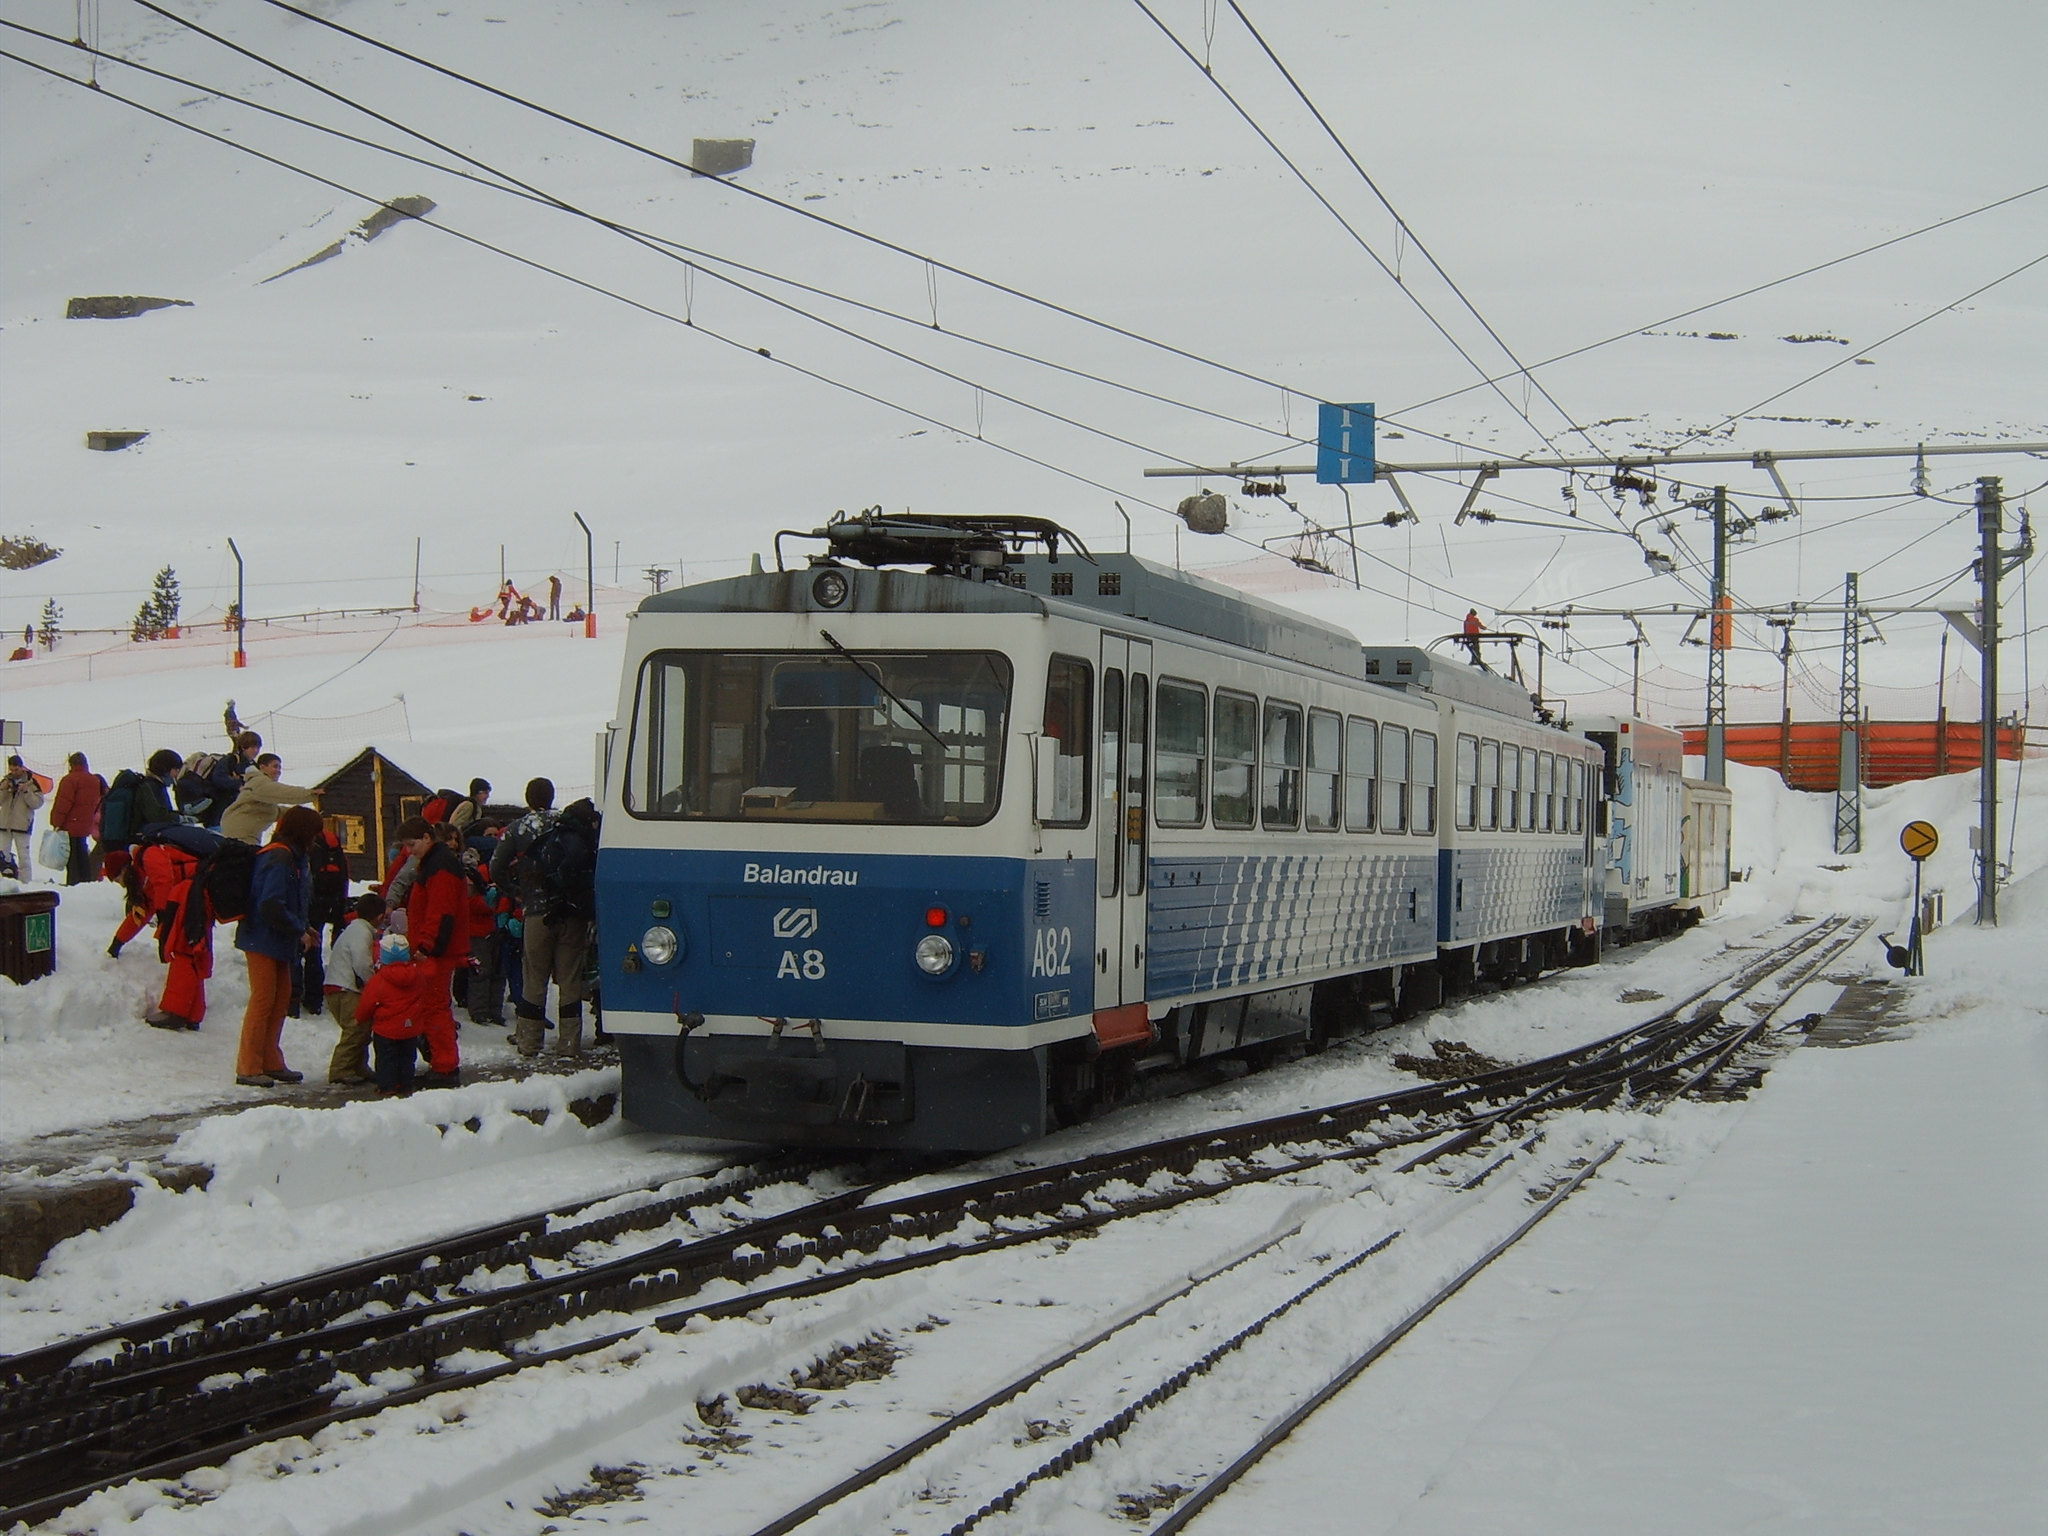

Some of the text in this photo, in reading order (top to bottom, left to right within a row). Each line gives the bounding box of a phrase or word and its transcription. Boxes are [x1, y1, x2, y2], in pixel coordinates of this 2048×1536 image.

[743, 863, 858, 885] Balandrau
[777, 949, 826, 980] A8
[1032, 926, 1071, 978] A8.2
